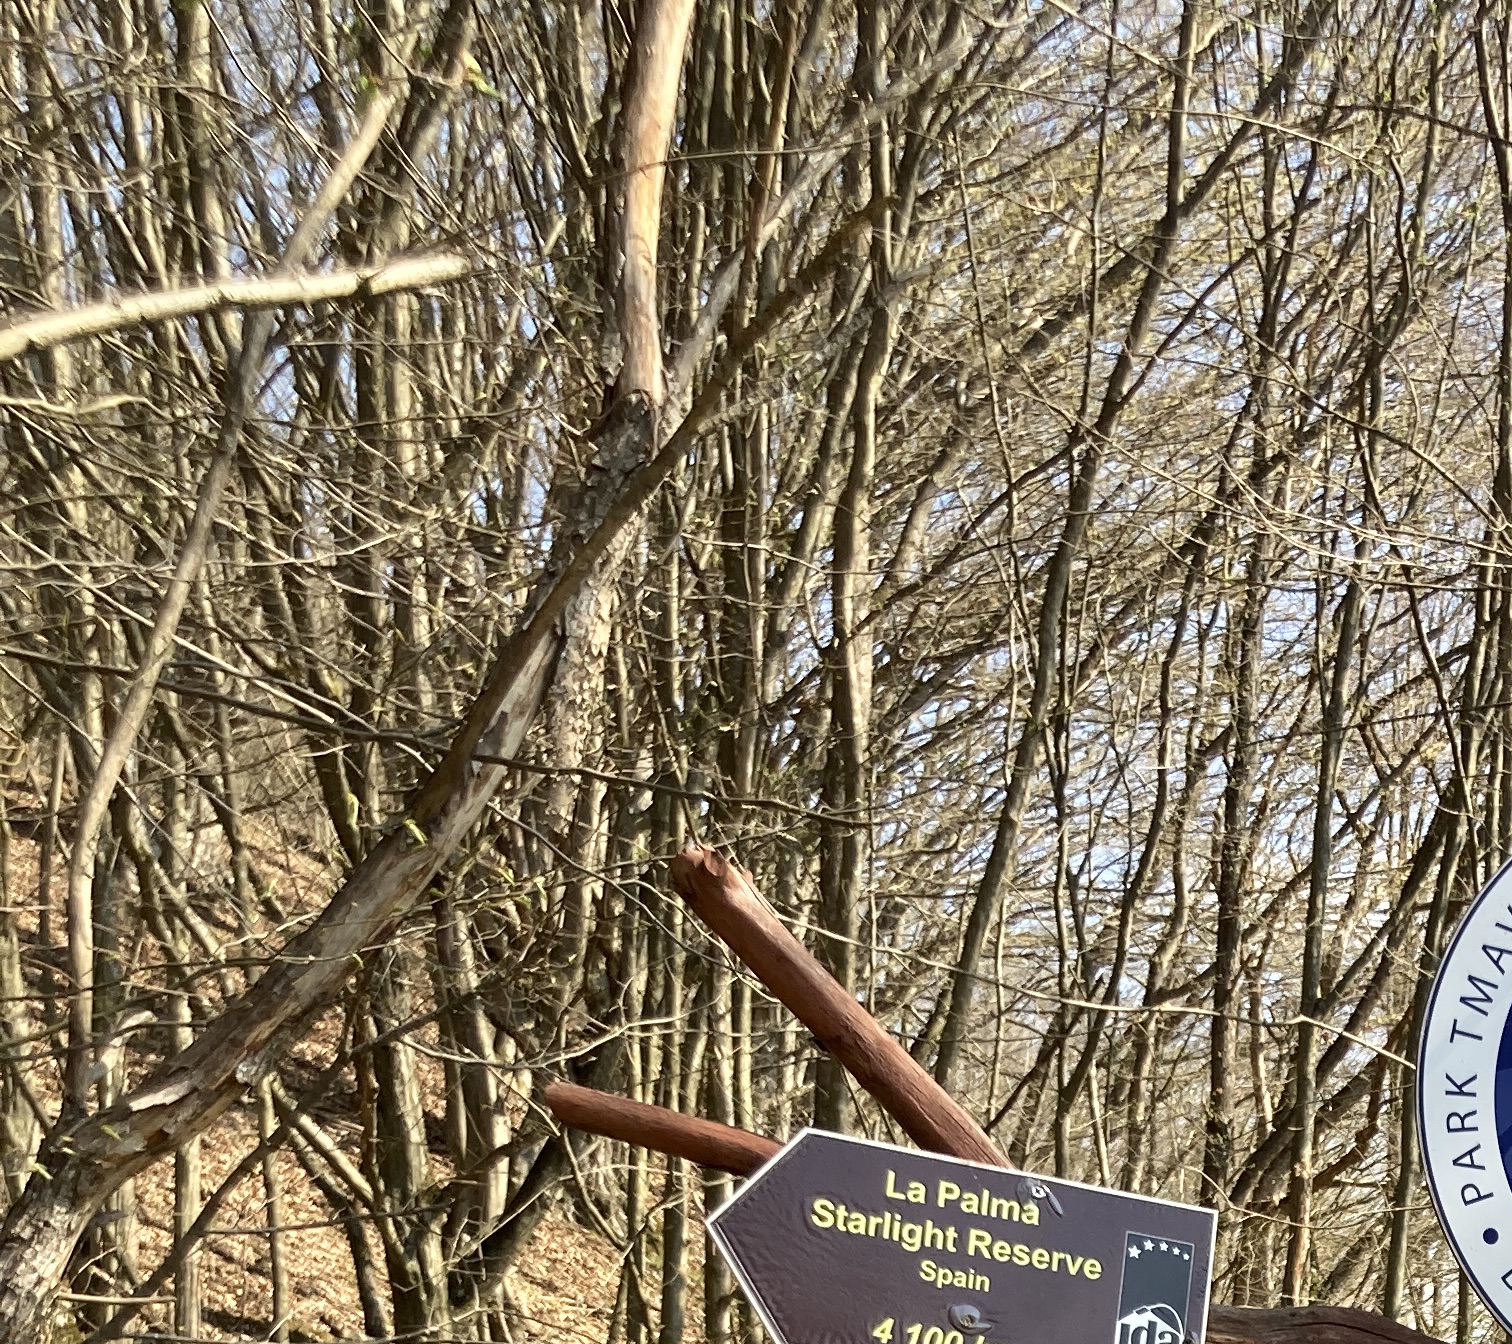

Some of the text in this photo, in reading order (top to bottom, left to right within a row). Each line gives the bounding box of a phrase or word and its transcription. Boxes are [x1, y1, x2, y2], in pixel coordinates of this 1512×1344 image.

[1444, 1071, 1494, 1206] PARK
[884, 1170, 1042, 1226] La Palma
[811, 1198, 1103, 1281] Starlight Reserve
[918, 1260, 992, 1293] Spain
[872, 1318, 895, 1344] 4
